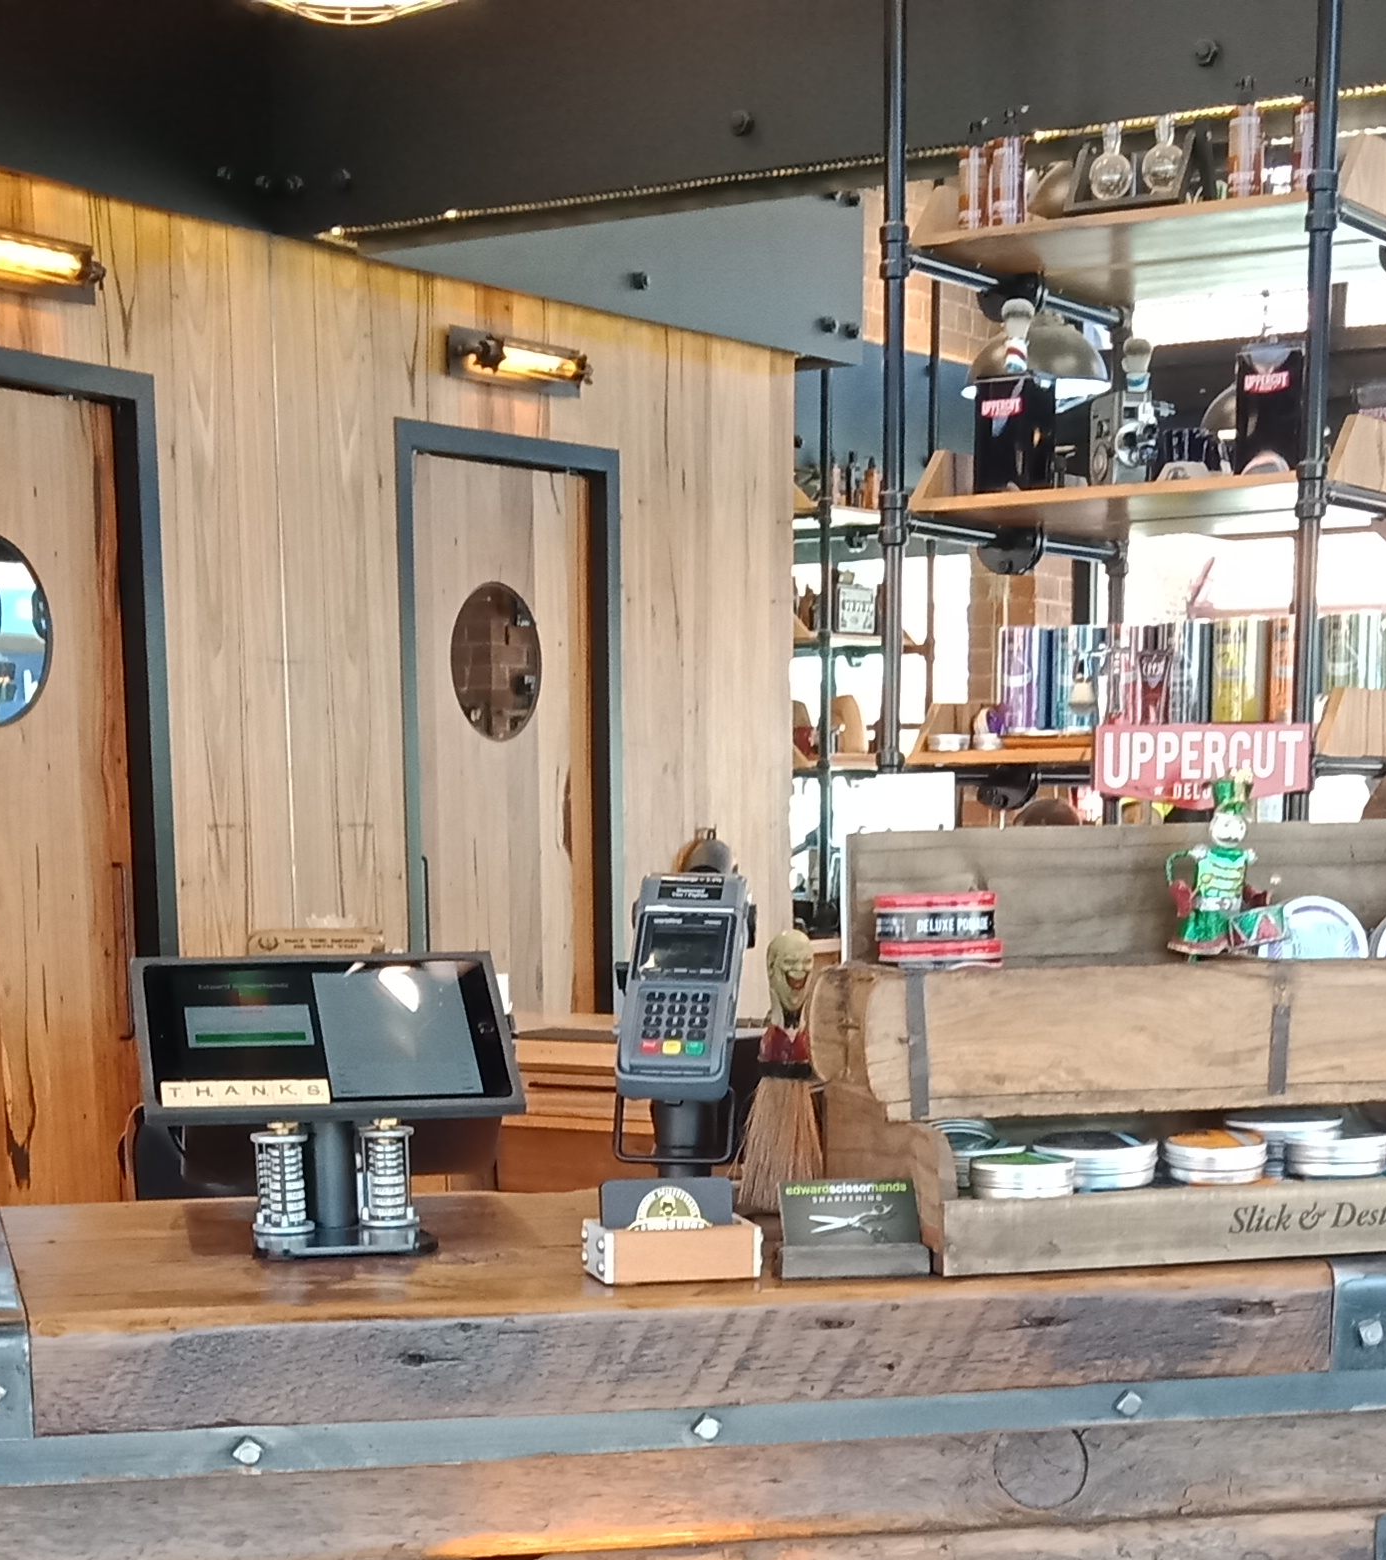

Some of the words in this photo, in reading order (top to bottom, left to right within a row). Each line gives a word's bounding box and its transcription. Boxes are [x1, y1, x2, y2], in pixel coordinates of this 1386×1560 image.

[1244, 371, 1291, 388] UPPERCUT
[980, 399, 1022, 417] UPPERCUT
[1103, 730, 1304, 789] UPPERCUT
[1173, 783, 1213, 800] DELU
[916, 918, 954, 933] DELUXE
[168, 1084, 320, 1099] THANKS
[784, 1182, 907, 1196] edwardscissorhands
[811, 1194, 883, 1204] SHARPENING
[1228, 1203, 1292, 1235] Slick
[1297, 1201, 1327, 1231] &
